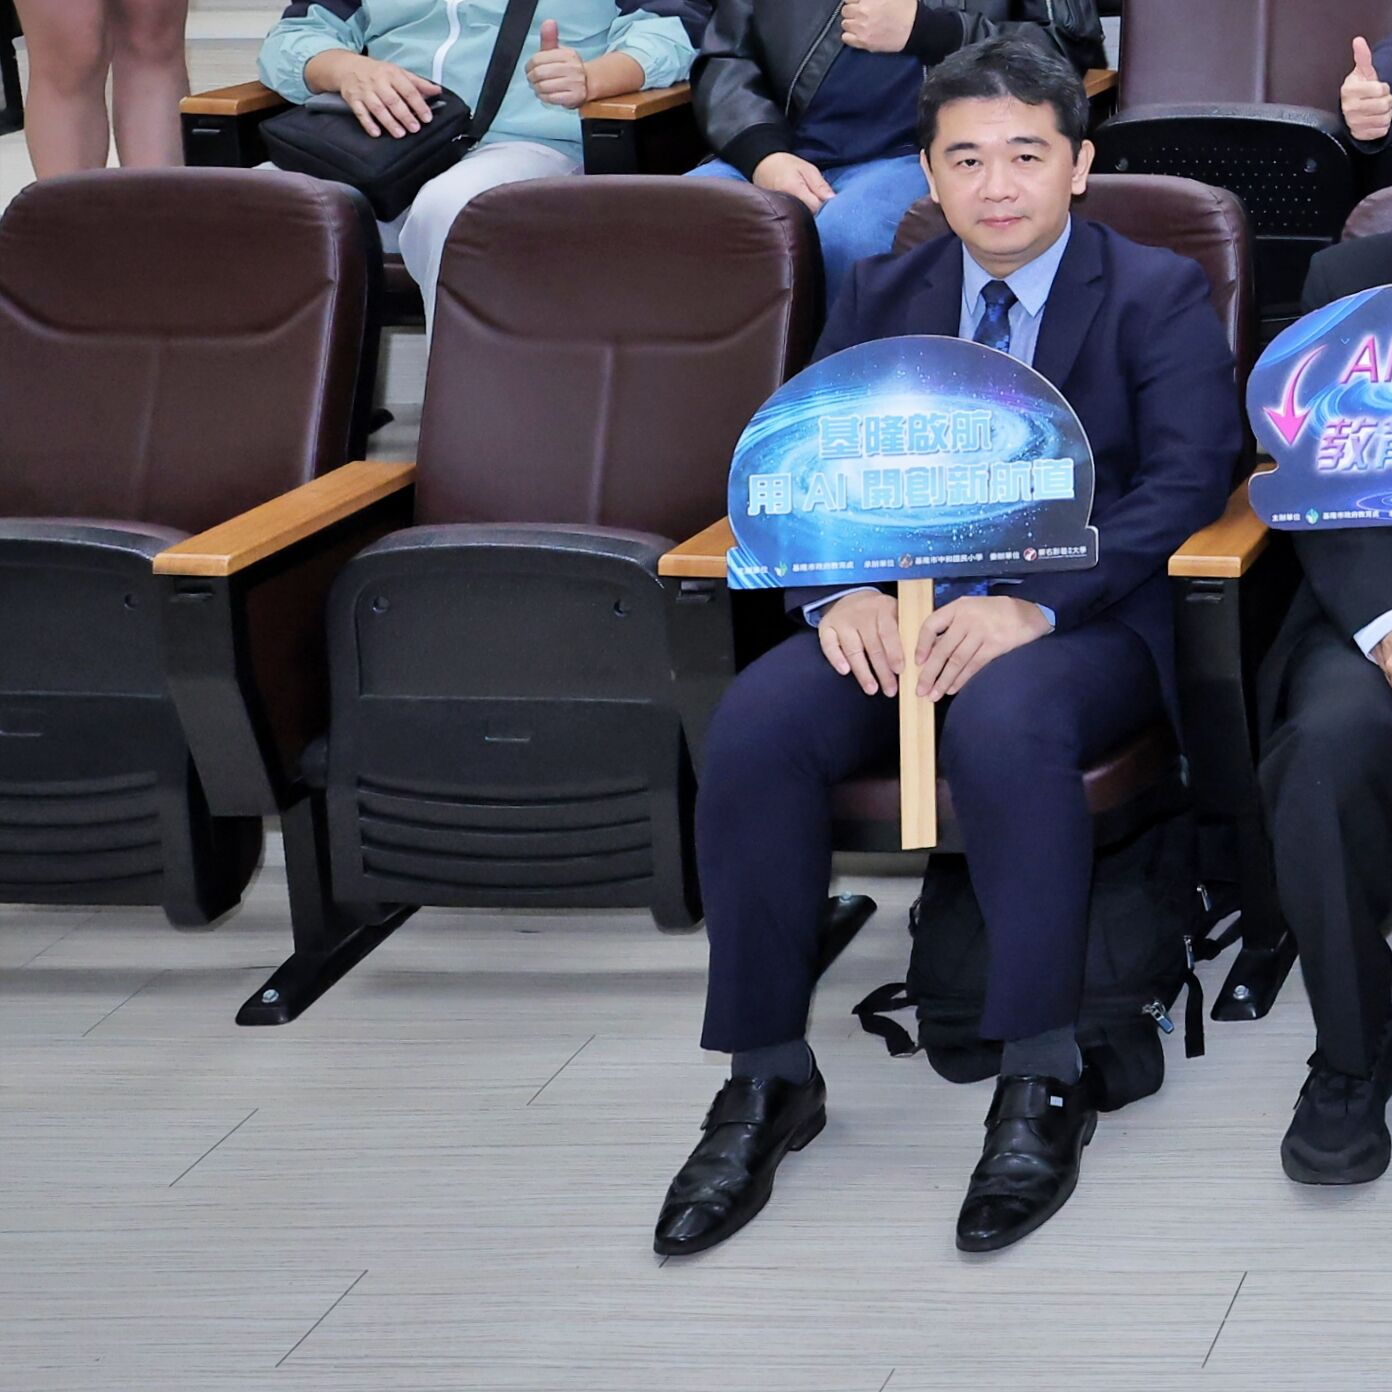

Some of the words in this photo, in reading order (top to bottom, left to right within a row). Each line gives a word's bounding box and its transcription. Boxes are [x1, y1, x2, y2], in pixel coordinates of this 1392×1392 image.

[818, 409, 993, 459] 基隆啟航
[747, 472, 792, 517] 用
[801, 470, 849, 513] AI
[861, 458, 1075, 511] 開創新航道
[989, 551, 1020, 561] 辦單位
